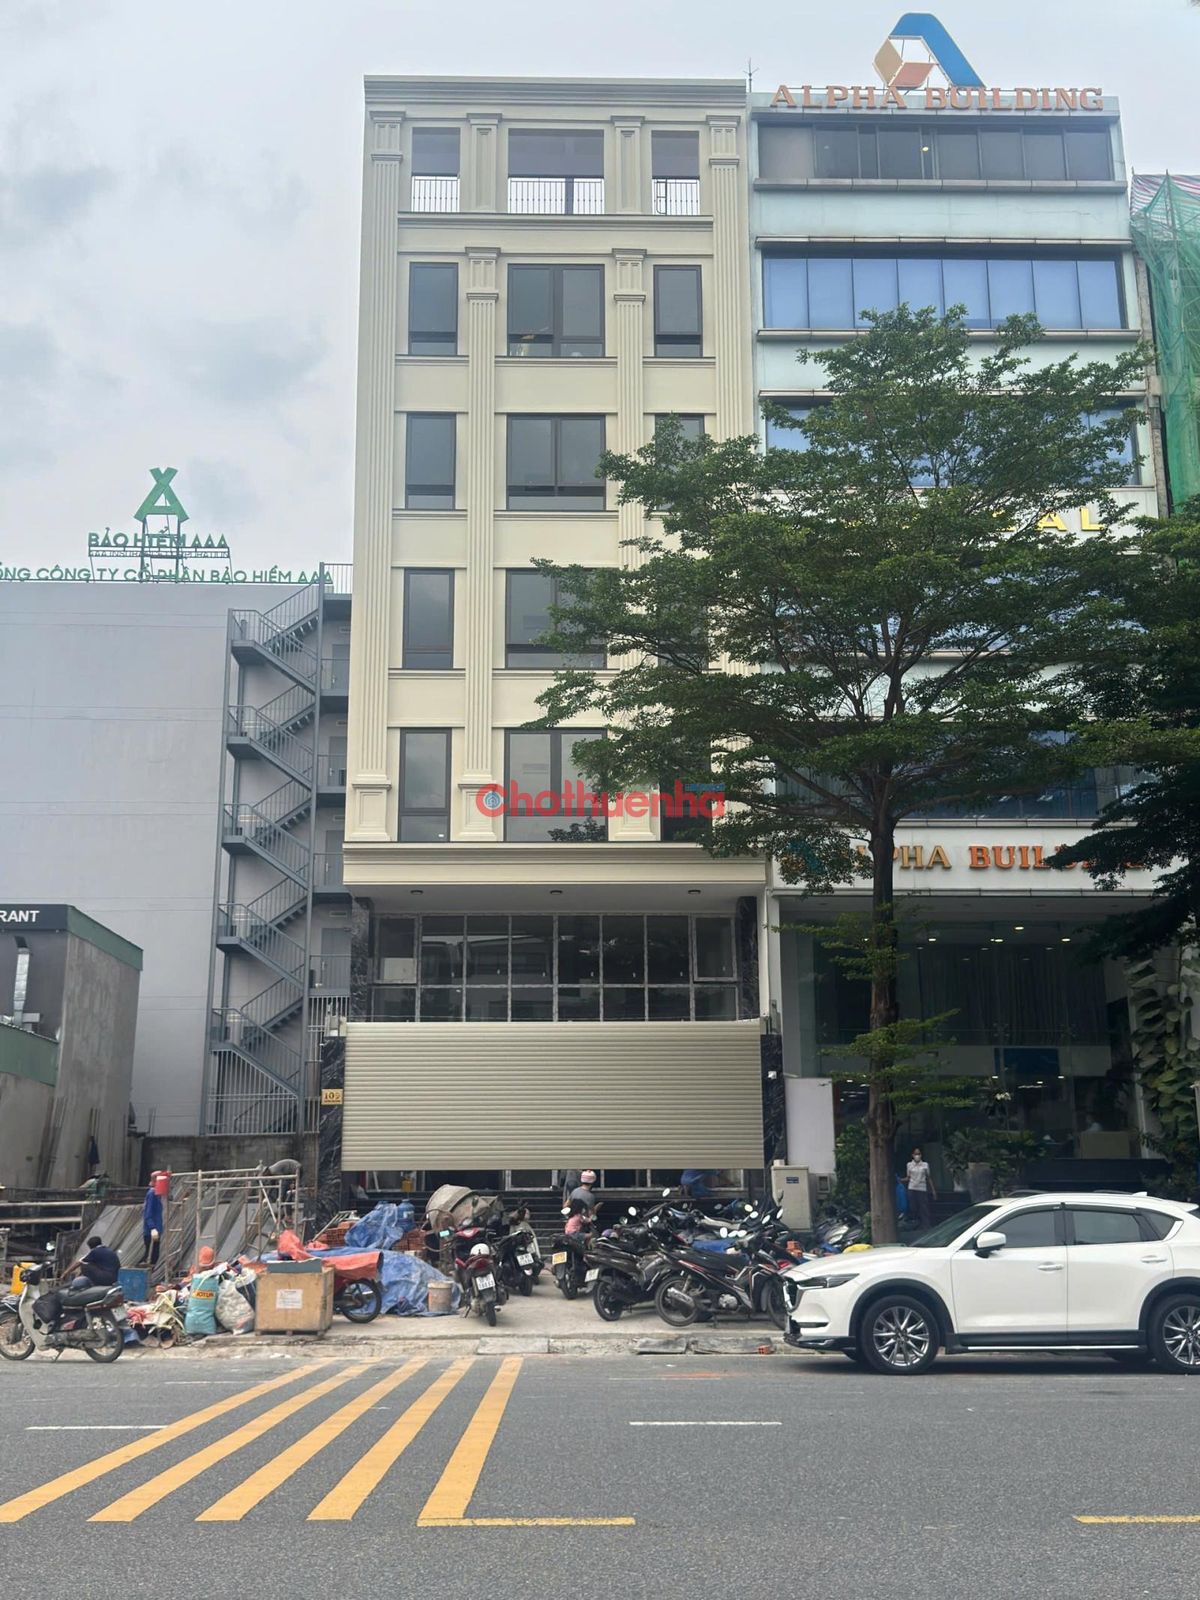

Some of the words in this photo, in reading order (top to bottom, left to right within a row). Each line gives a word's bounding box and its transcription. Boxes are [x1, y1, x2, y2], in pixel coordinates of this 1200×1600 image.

[770, 84, 908, 110] ALPHA
[924, 87, 1104, 111] BUILDING
[88, 527, 129, 547] BẢO
[191, 533, 229, 547] AAA
[0, 561, 31, 580] NG
[36, 564, 91, 581] CÔNG
[97, 568, 119, 580] TY
[210, 566, 247, 583] BẢO
